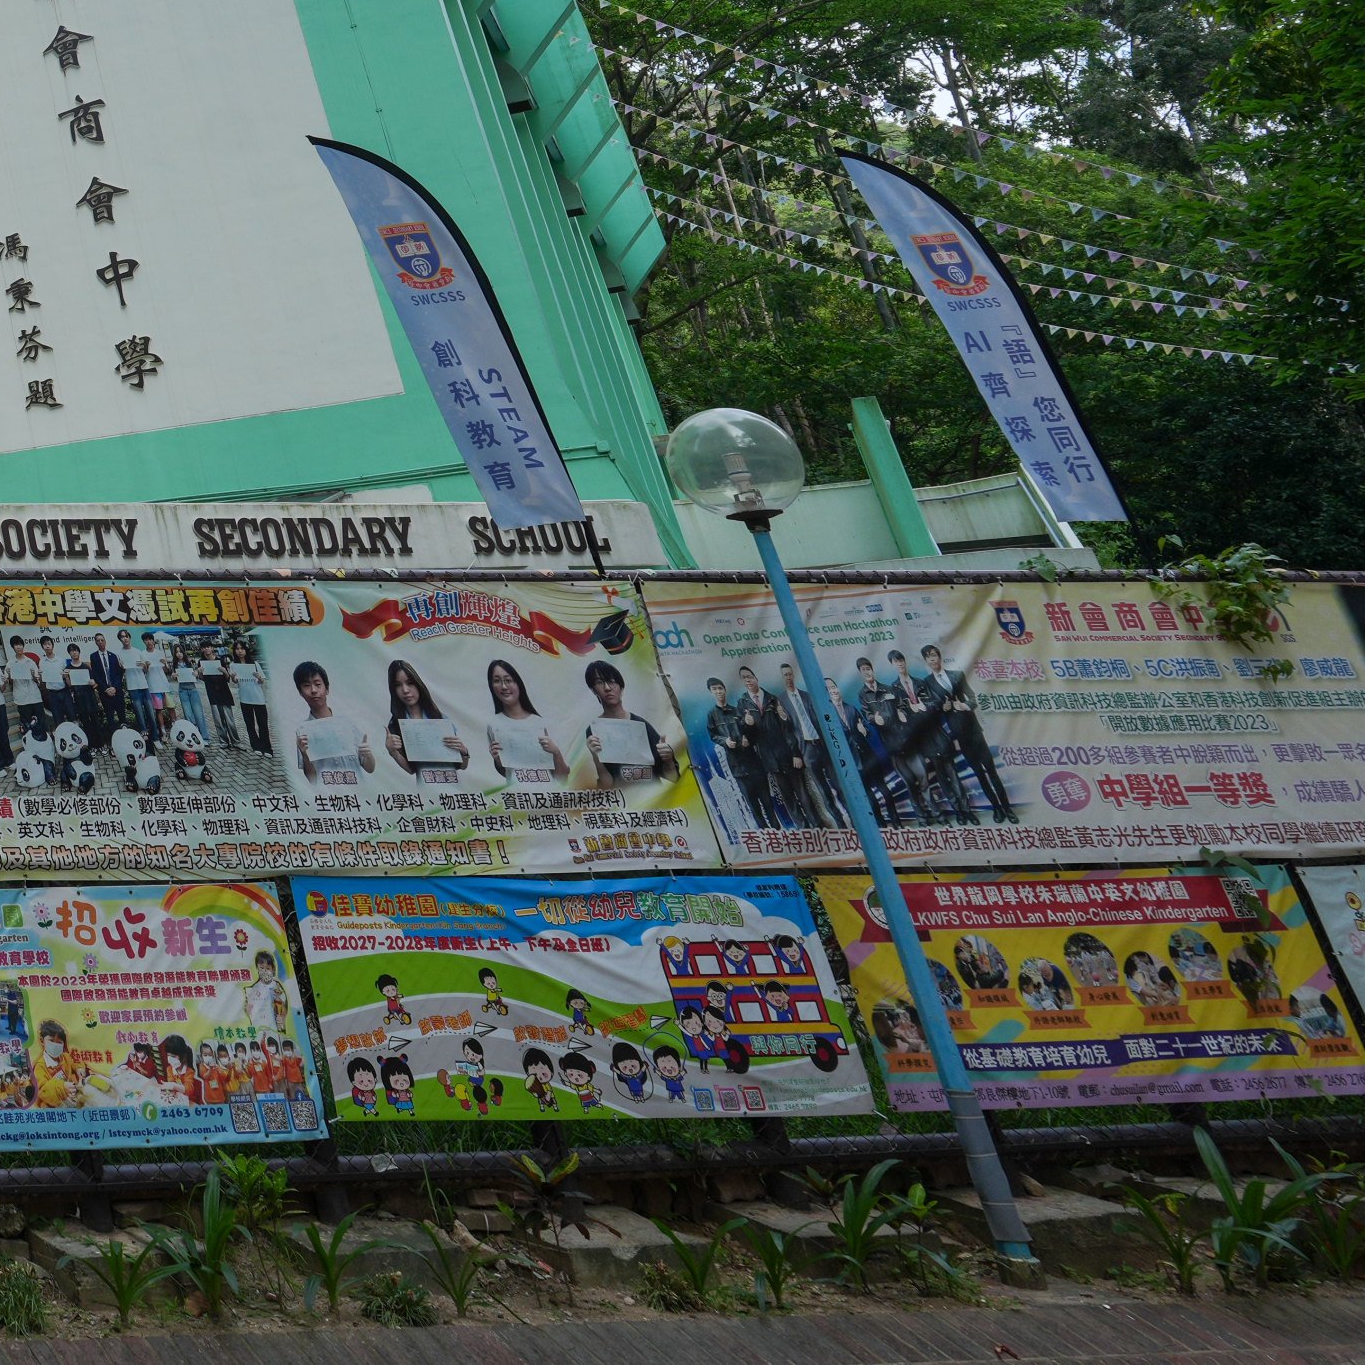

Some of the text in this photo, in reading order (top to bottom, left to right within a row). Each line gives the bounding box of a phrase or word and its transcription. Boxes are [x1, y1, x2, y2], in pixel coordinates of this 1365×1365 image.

[411, 290, 466, 306] SWCSSS
[947, 297, 1002, 312] SWCSSS
[431, 339, 516, 490] 創科教育
[478, 368, 545, 468] STEAM
[193, 516, 414, 558] SECONDARY
[403, 591, 520, 628] 再創輝煌
[410, 622, 540, 652] Reach Greater Heights
[703, 616, 900, 647] Open Data cum Hackathon
[720, 642, 792, 659] Appreciation
[816, 633, 869, 649] Ceremony
[870, 630, 895, 643] 2023
[973, 658, 1045, 682] 恭喜本校
[1047, 777, 1086, 803] 勇奪
[1096, 772, 1276, 808] 中學組一等獎
[515, 891, 744, 927] 一切從幼兒教育開始
[912, 905, 1228, 926] LKWFS Chu Sui Lan Anglo-Chinese Kindergarten
[56, 900, 232, 960] 招收新生
[963, 1044, 1112, 1069] 從基礎教育培育幼兒
[161, 1105, 224, 1119] 2463 6709
